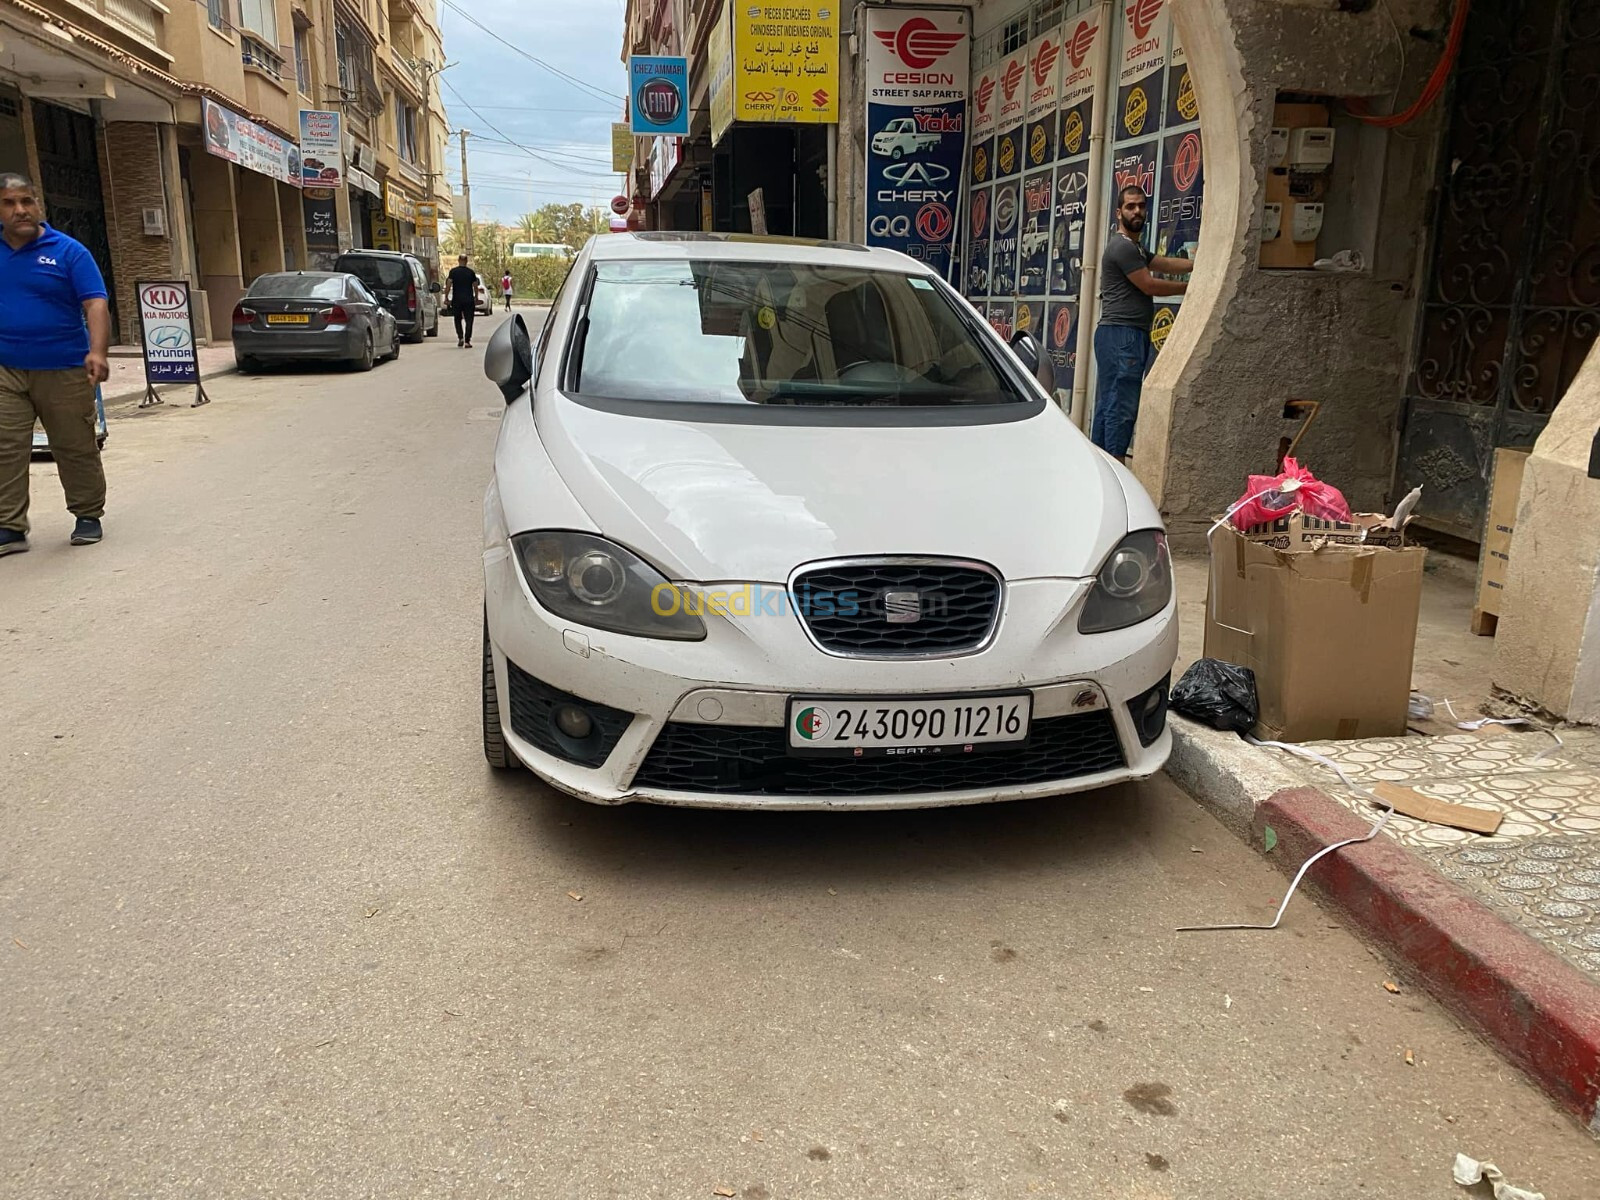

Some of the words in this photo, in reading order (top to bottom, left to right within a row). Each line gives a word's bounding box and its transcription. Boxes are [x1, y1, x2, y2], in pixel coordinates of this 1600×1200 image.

[764, 6, 781, 19] PIÈCES
[782, 6, 811, 20] DÉTACHÉES
[750, 24, 776, 36] CHINOISES
[777, 25, 783, 36] ET
[784, 25, 809, 37] INDIENNES
[810, 26, 832, 38] ORIGINAL
[755, 42, 784, 56] السيارات
[788, 42, 802, 56] غيار
[805, 41, 818, 59] قطع
[634, 64, 652, 74] CHEZ
[655, 64, 684, 75] AMMARI
[771, 59, 793, 77] الهندية
[797, 66, 801, 76] و
[804, 60, 828, 76] الصينية
[649, 92, 673, 113] FIAT
[914, 113, 962, 132] Yoki
[1115, 154, 1142, 169] CHERY
[878, 190, 953, 202] CHERY
[1056, 202, 1087, 217] CHERY
[870, 215, 910, 237] QQ
[149, 291, 179, 304] KIA
[834, 709, 946, 740] 243090
